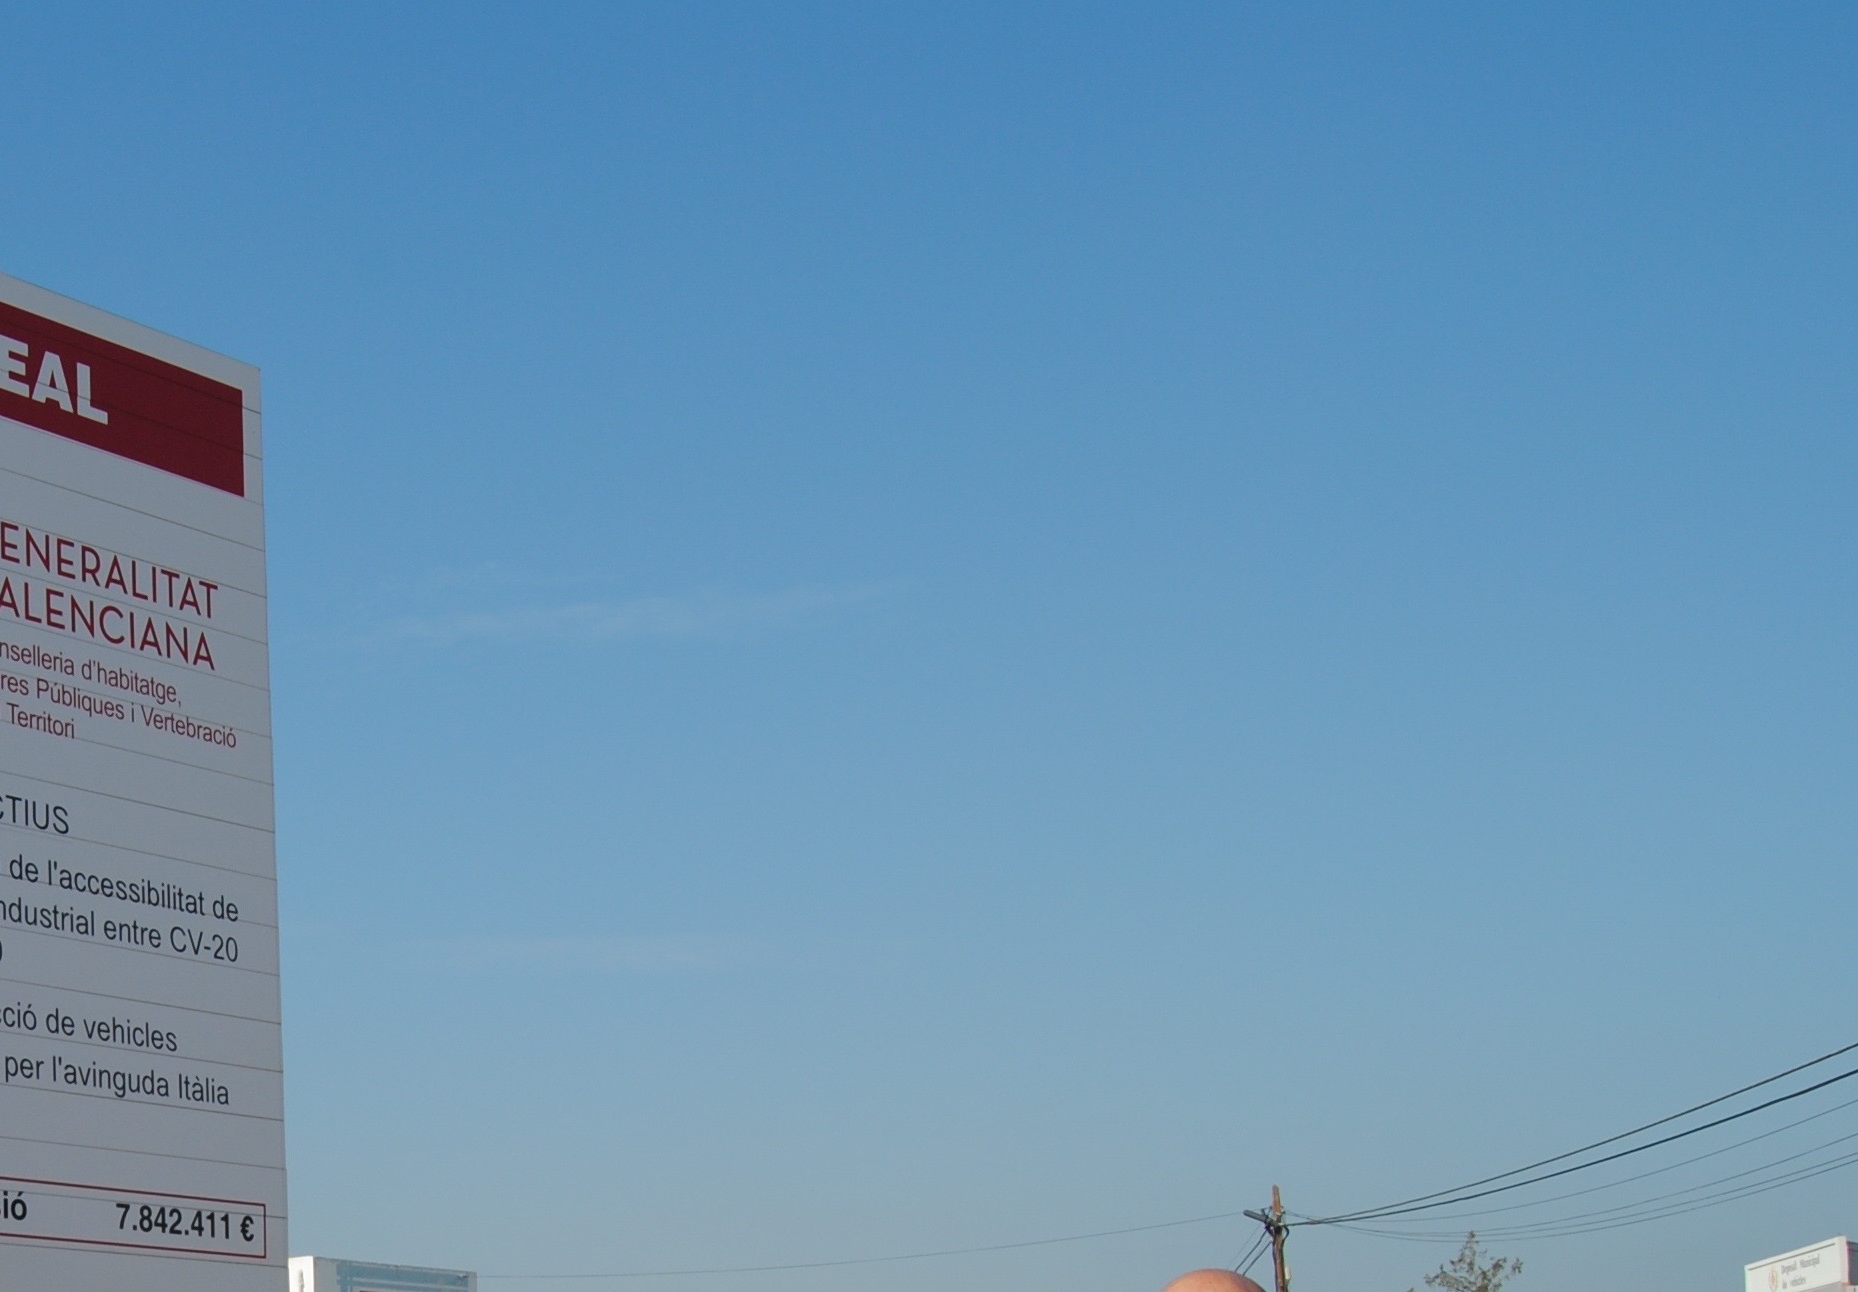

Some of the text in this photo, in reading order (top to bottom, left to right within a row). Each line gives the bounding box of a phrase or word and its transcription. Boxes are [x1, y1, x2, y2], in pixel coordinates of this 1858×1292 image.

[81, 659, 182, 708] d'habitatge,
[9, 703, 75, 739] Territori
[36, 679, 125, 721] Públiques
[130, 701, 135, 723] i
[141, 704, 237, 749] Vertebració
[9, 854, 39, 884] de
[47, 860, 205, 916] l'accessibilitat
[212, 894, 239, 923] de
[103, 918, 162, 949] entre
[169, 925, 239, 964] CV-20
[45, 1008, 75, 1036] de
[83, 1016, 178, 1053] vehicles
[4, 1054, 44, 1083] per
[52, 1056, 170, 1100] l'avinguda
[178, 1074, 230, 1105] Itàlia
[115, 1202, 231, 1241] 7.842.411
[240, 1215, 255, 1243] €
